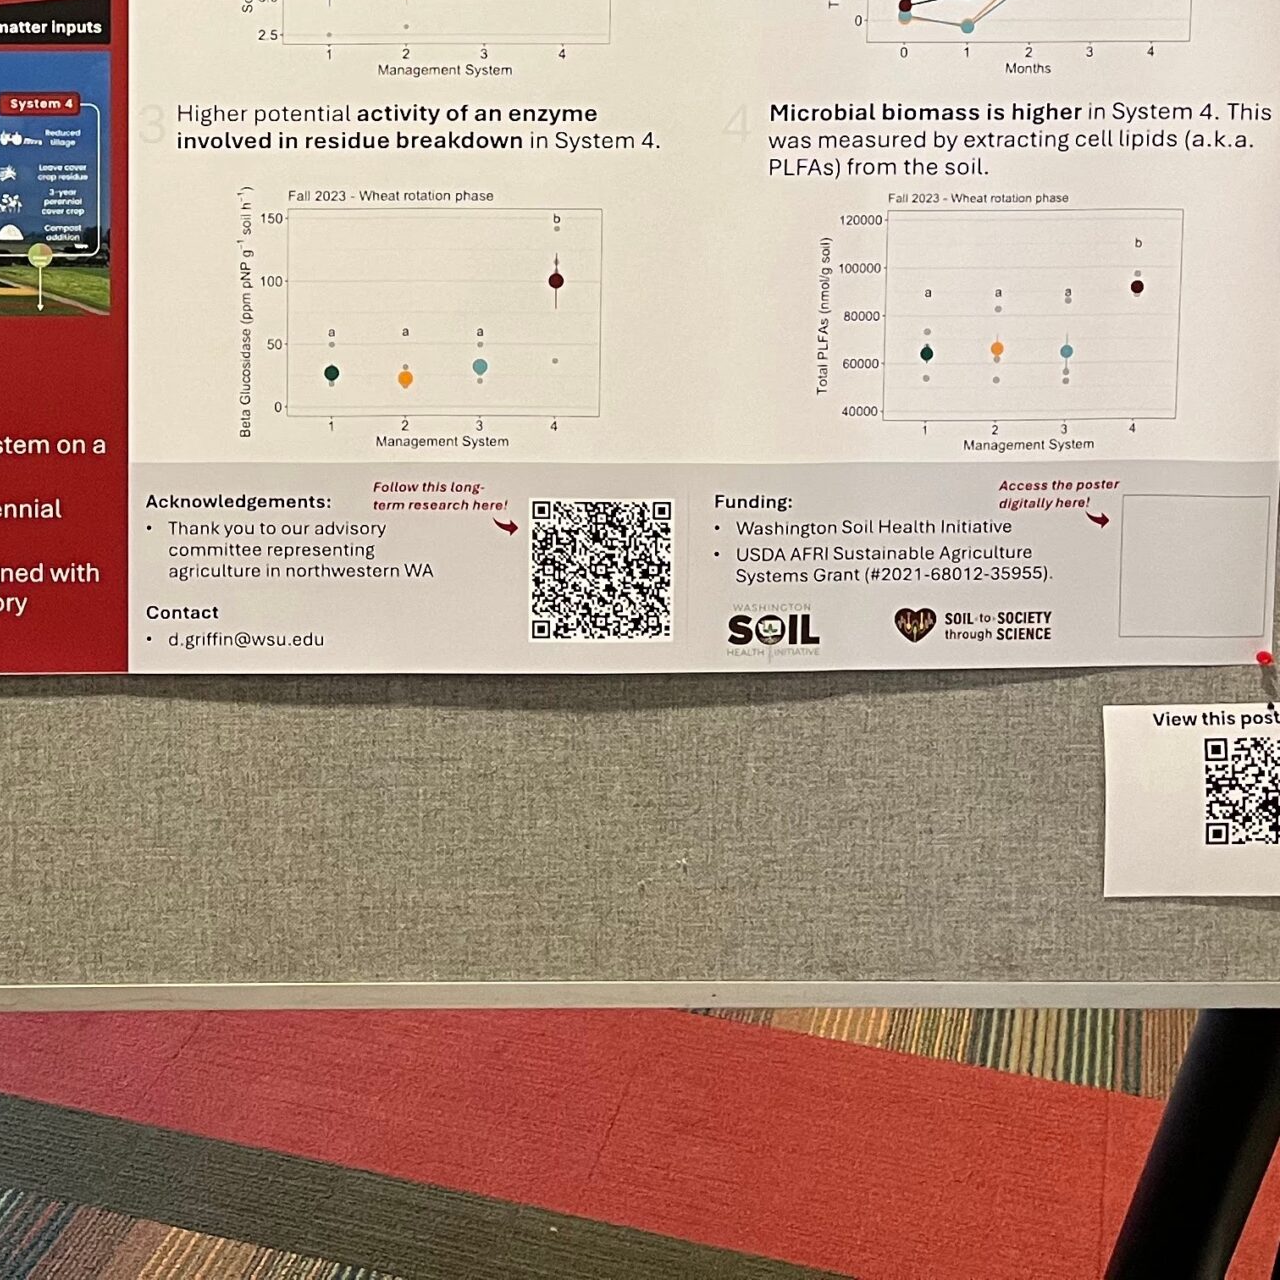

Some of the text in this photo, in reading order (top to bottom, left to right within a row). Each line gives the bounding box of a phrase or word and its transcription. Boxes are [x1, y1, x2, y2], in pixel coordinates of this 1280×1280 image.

[51, 19, 103, 37] inputs
[258, 28, 278, 41] 2.5
[377, 63, 513, 79] Management System
[1005, 62, 1052, 74] Months
[10, 98, 73, 112] System 4
[839, 214, 883, 226] 120000
[838, 262, 882, 274] 100000
[843, 310, 881, 322] 80000
[842, 358, 880, 370] 60000
[841, 405, 879, 417] 40000
[373, 481, 485, 496] Follow this long-
[145, 493, 331, 512] Acknowledgements:
[373, 499, 509, 511] term research here!
[714, 494, 793, 513] Funding:
[735, 519, 1012, 539] Washington Soil Health Initiative
[736, 545, 1033, 563] USDA AFRI Sustainable Agriculture
[146, 605, 219, 620] Contact
[732, 603, 812, 612] WASHINGTON
[944, 612, 974, 625] SOIL
[997, 610, 1053, 625] SOCIETY
[727, 613, 821, 646] SOIL
[944, 627, 1052, 642] through SCIENCE
[168, 631, 324, 650] d.griffin@wsu.edu
[1152, 711, 1198, 727] View
[1201, 710, 1236, 726] this
